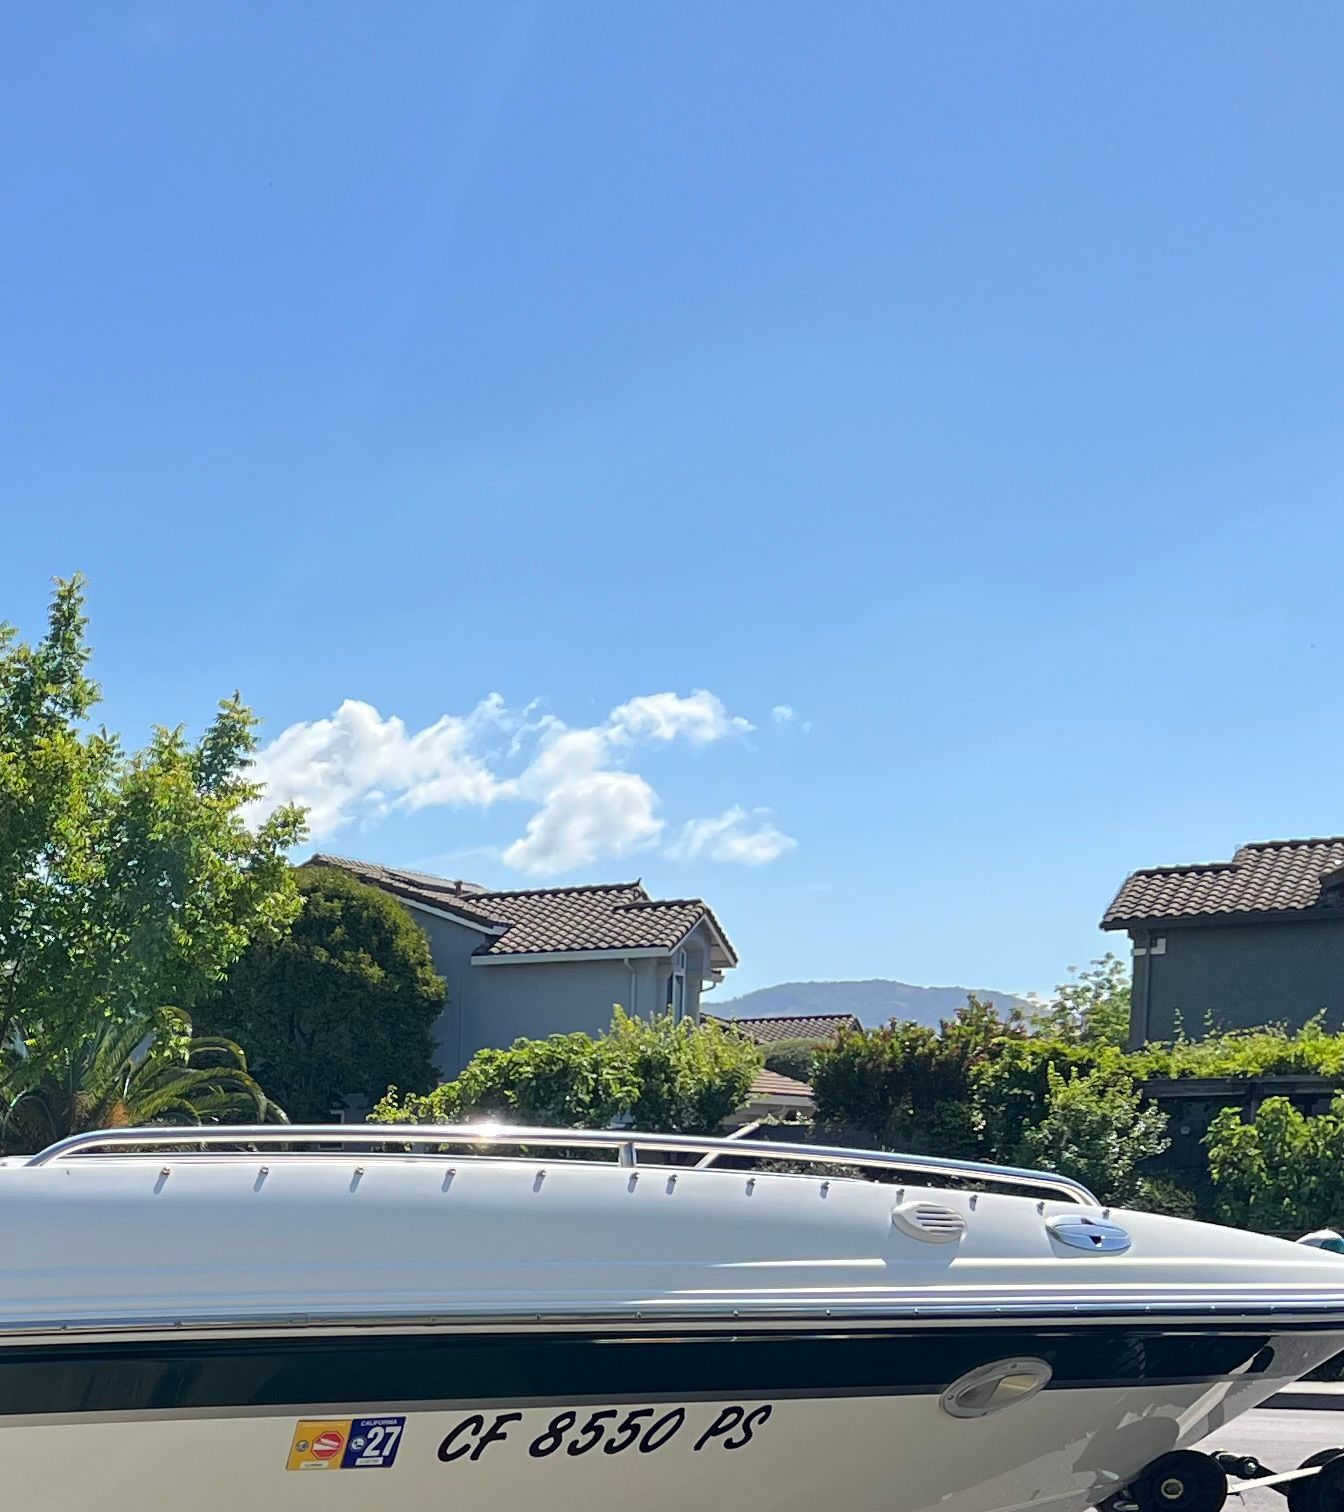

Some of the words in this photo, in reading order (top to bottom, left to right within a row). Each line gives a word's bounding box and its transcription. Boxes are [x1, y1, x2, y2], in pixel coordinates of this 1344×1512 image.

[362, 1426, 402, 1457] 27
[437, 1413, 522, 1462] CF
[529, 1407, 685, 1458] 8550
[694, 1404, 773, 1451] PS
